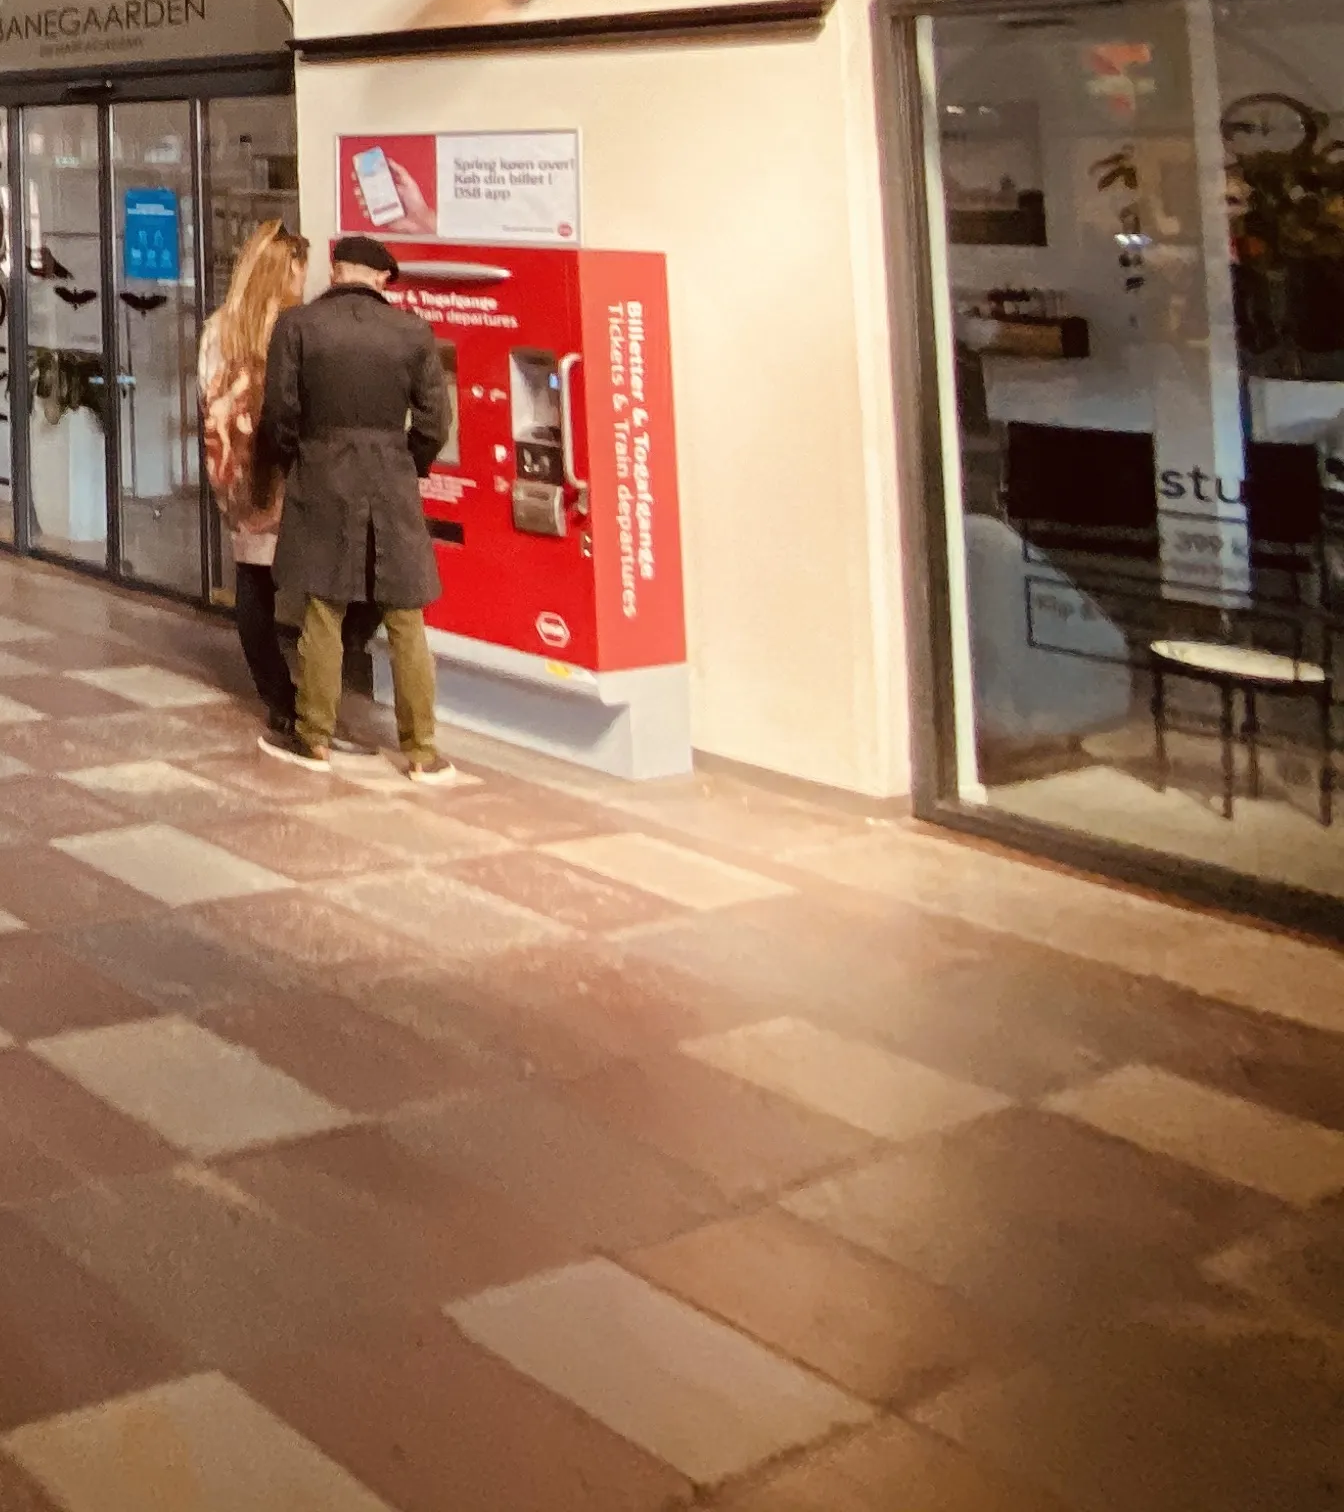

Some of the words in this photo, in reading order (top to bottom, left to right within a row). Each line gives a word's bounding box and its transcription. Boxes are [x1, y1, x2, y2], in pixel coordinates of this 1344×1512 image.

[446, 308, 519, 330] departures
[607, 302, 626, 387] Tickets
[626, 300, 645, 402] Billetter
[612, 392, 629, 413] &
[631, 406, 649, 428] &
[613, 418, 631, 479] Train
[615, 484, 638, 620] departures
